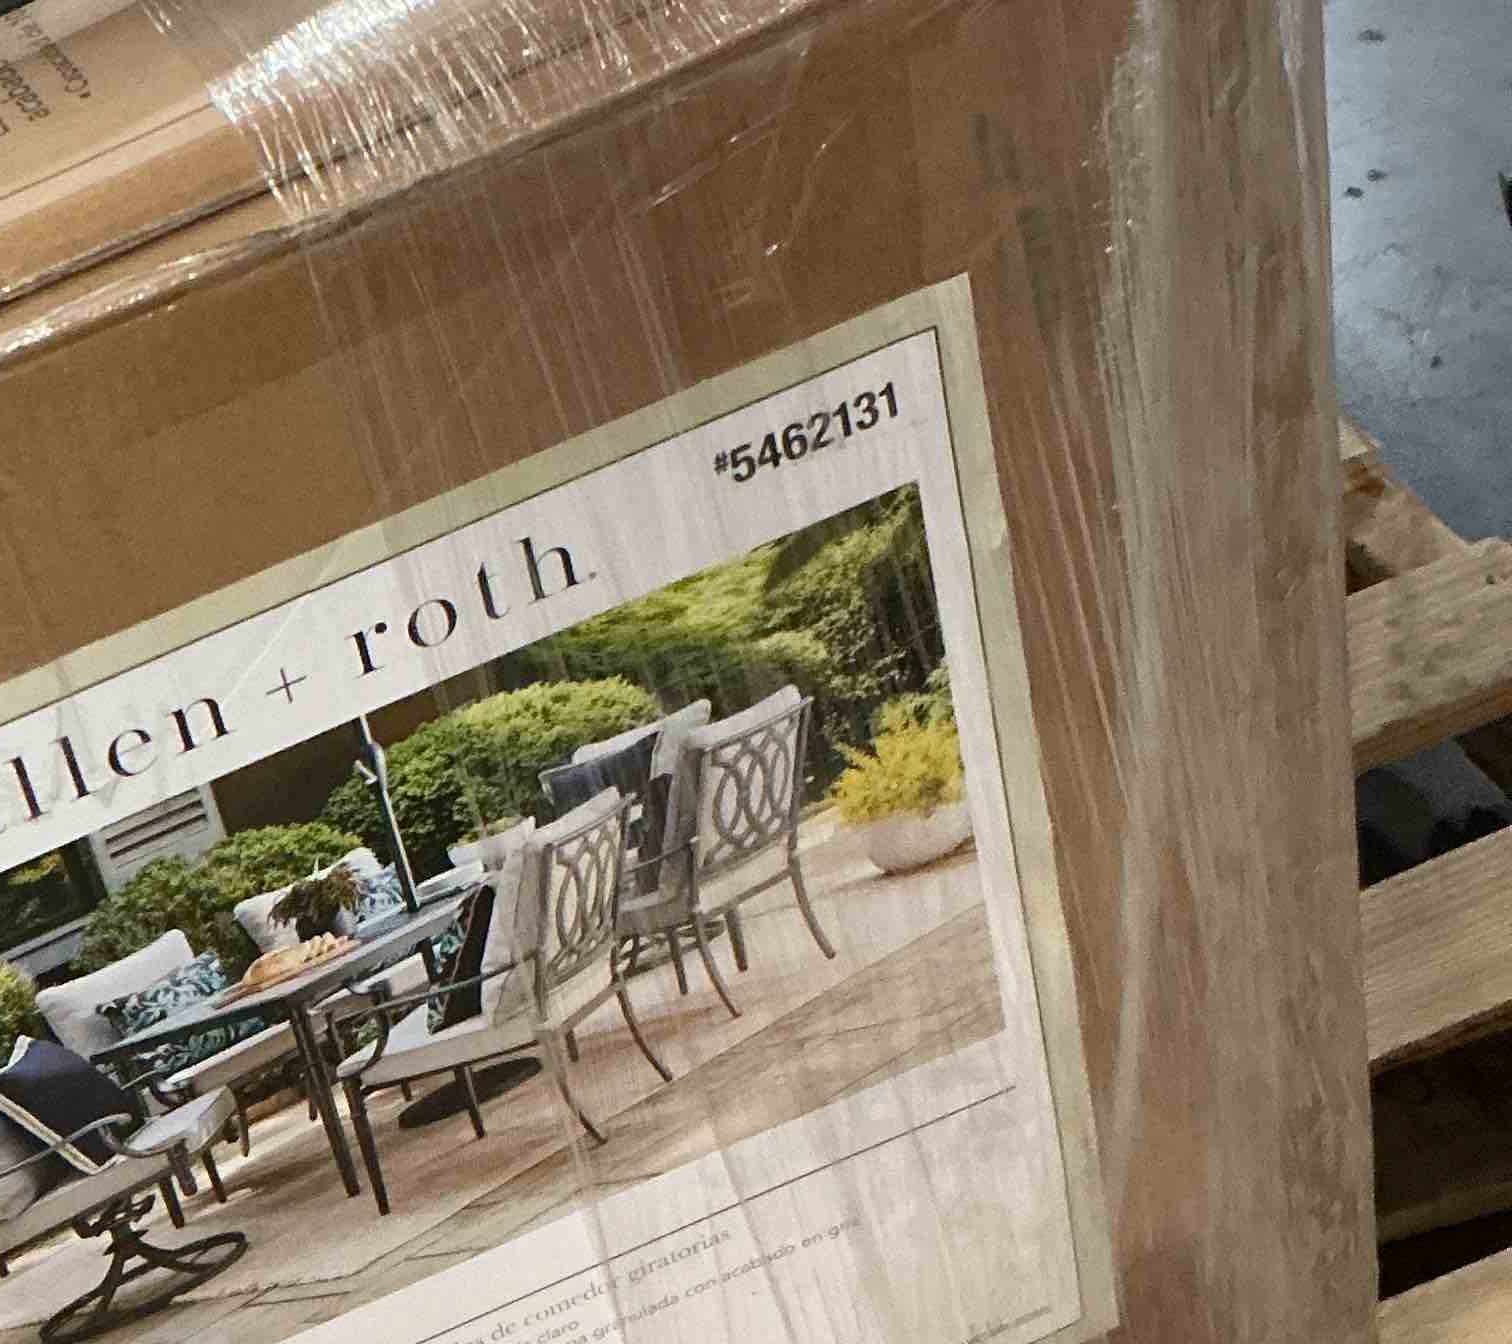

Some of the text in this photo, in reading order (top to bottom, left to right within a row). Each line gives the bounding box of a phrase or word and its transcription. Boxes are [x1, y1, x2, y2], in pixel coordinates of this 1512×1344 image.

[713, 381, 898, 484] #5462131
[265, 665, 308, 705] +
[491, 1320, 517, 1343] de
[627, 1228, 731, 1285] giratorias
[684, 1277, 716, 1299] con
[801, 1235, 823, 1249] en
[537, 1320, 580, 1344] claro
